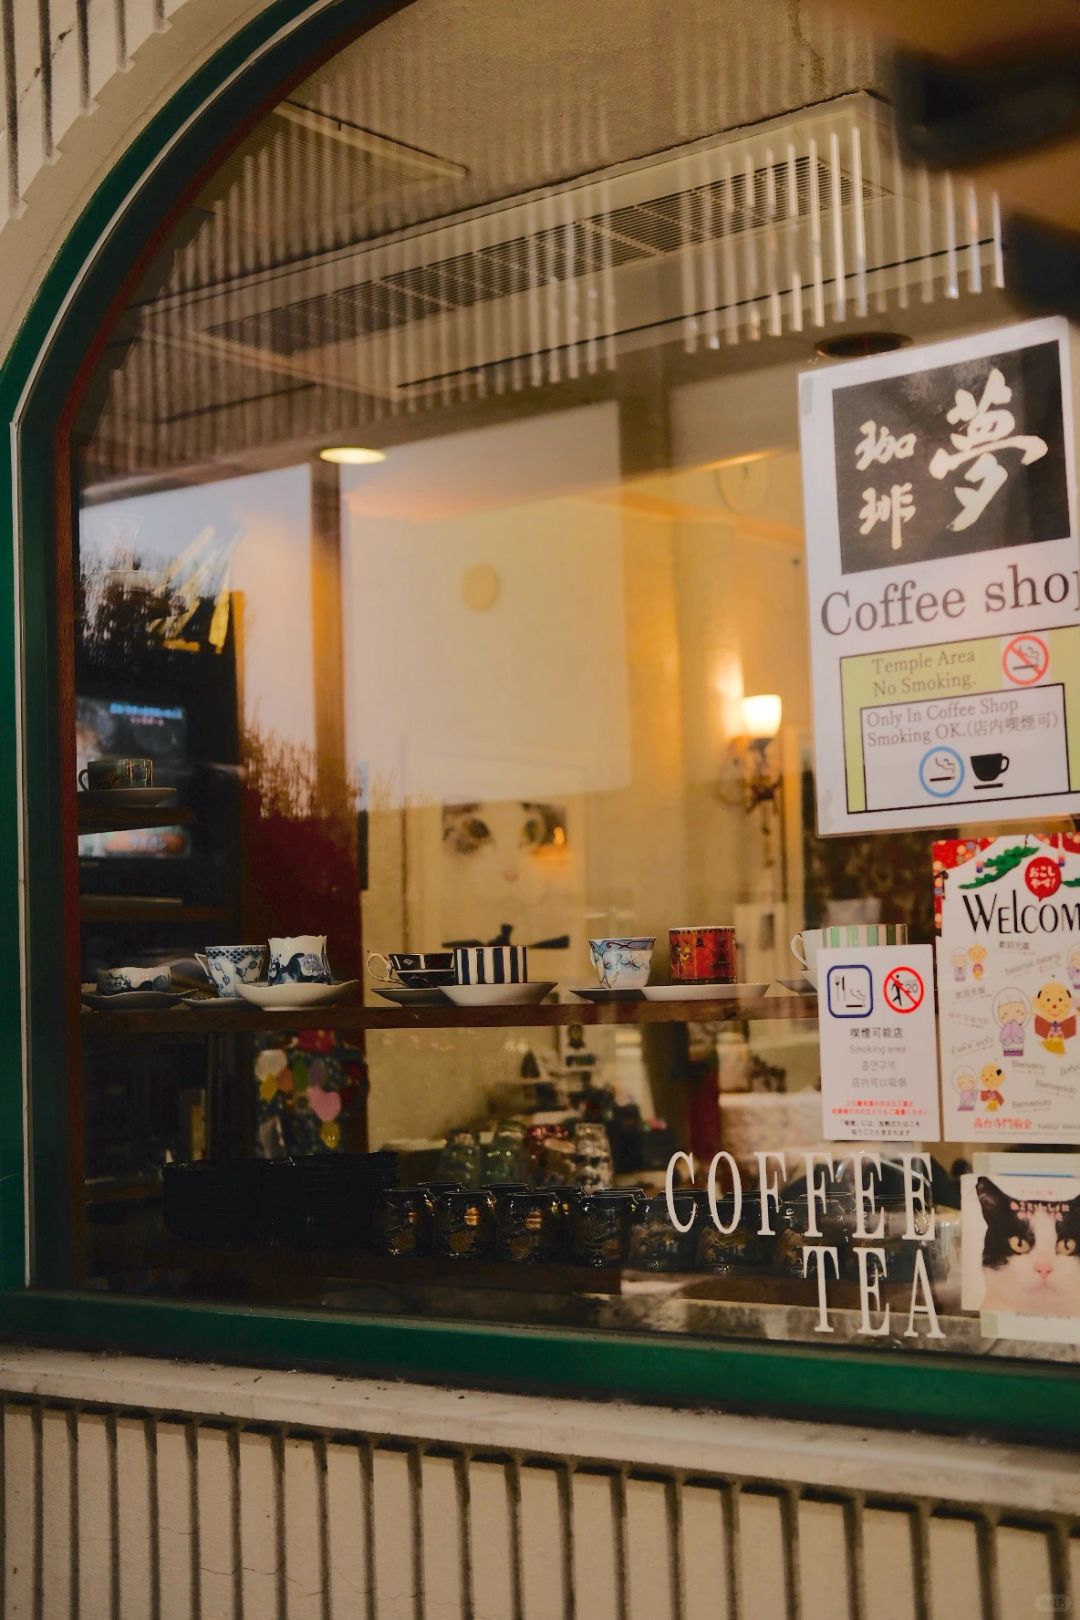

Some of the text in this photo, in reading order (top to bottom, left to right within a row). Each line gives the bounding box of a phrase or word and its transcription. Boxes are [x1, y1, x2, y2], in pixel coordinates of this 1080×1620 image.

[929, 367, 1048, 532] 夢
[855, 420, 917, 550] 珈琲
[821, 564, 1080, 636] Coffee sho
[872, 650, 975, 675] Temple Area
[873, 673, 976, 698] No Smoking.
[867, 698, 1019, 727] Only In Coffee Shop
[867, 727, 932, 747] Smoking
[850, 1044, 885, 1055] Smoking
[665, 1151, 936, 1240] COFFEE
[802, 1246, 946, 1339] TEA
